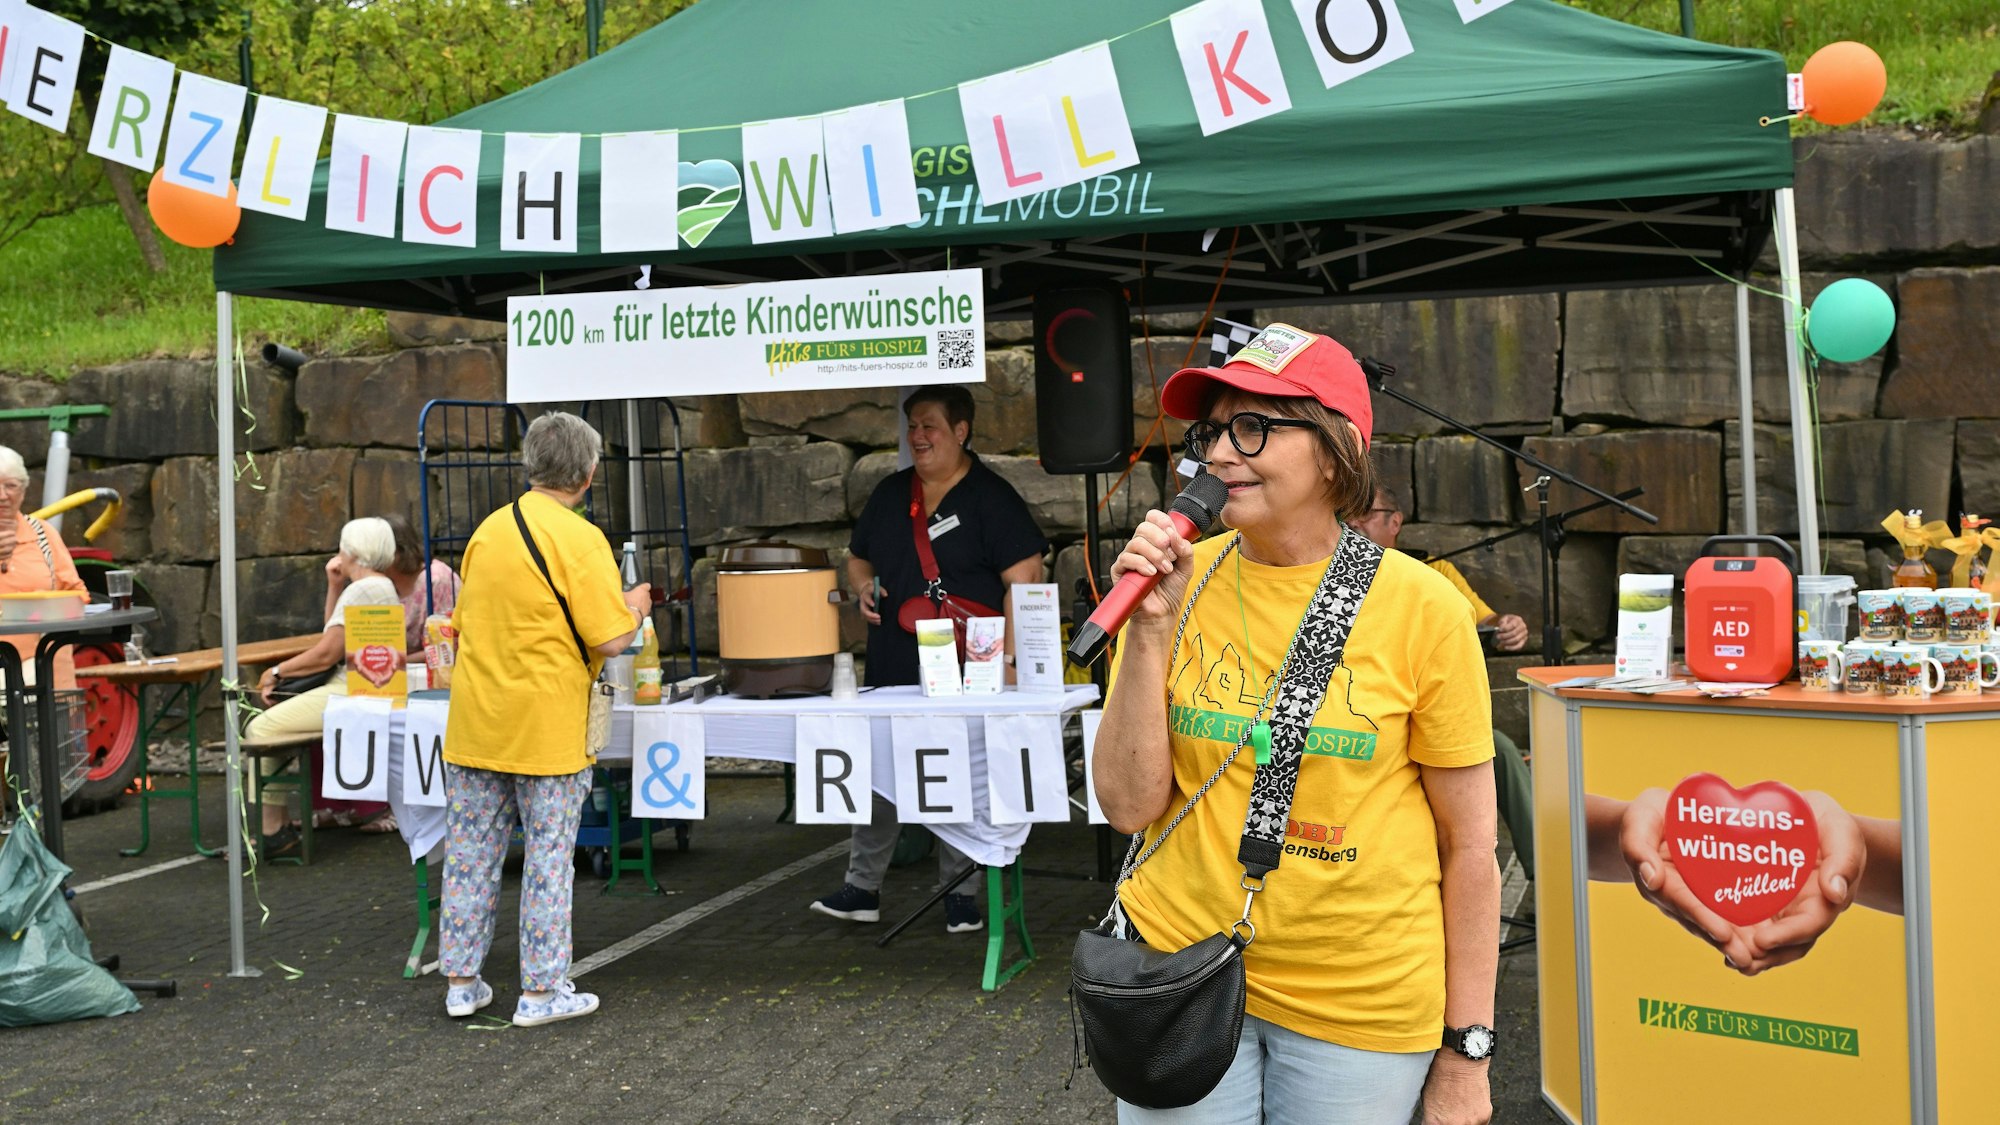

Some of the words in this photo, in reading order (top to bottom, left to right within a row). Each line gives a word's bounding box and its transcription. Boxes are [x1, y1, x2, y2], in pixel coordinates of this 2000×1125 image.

[912, 144, 971, 177] GIS
[512, 308, 574, 347] 1200
[584, 325, 605, 344] km
[613, 304, 653, 342] für
[663, 302, 736, 339] letzte
[747, 286, 973, 335] Kinderwünsche
[768, 339, 811, 376] Hits
[862, 339, 922, 356] HOSPIZ
[817, 361, 928, 373] http://hits-fuers-hospiz.de
[1712, 621, 1750, 637] AED
[1305, 731, 1369, 758] OSPIZ
[641, 741, 696, 810] &
[1677, 797, 1804, 831] Herzens-
[1280, 839, 1358, 863] ensberg
[1677, 834, 1806, 868] wünsche
[1714, 866, 1798, 905] erfüllen!
[1644, 996, 1698, 1033] Hits
[1768, 1020, 1853, 1051] HOSPIZ
